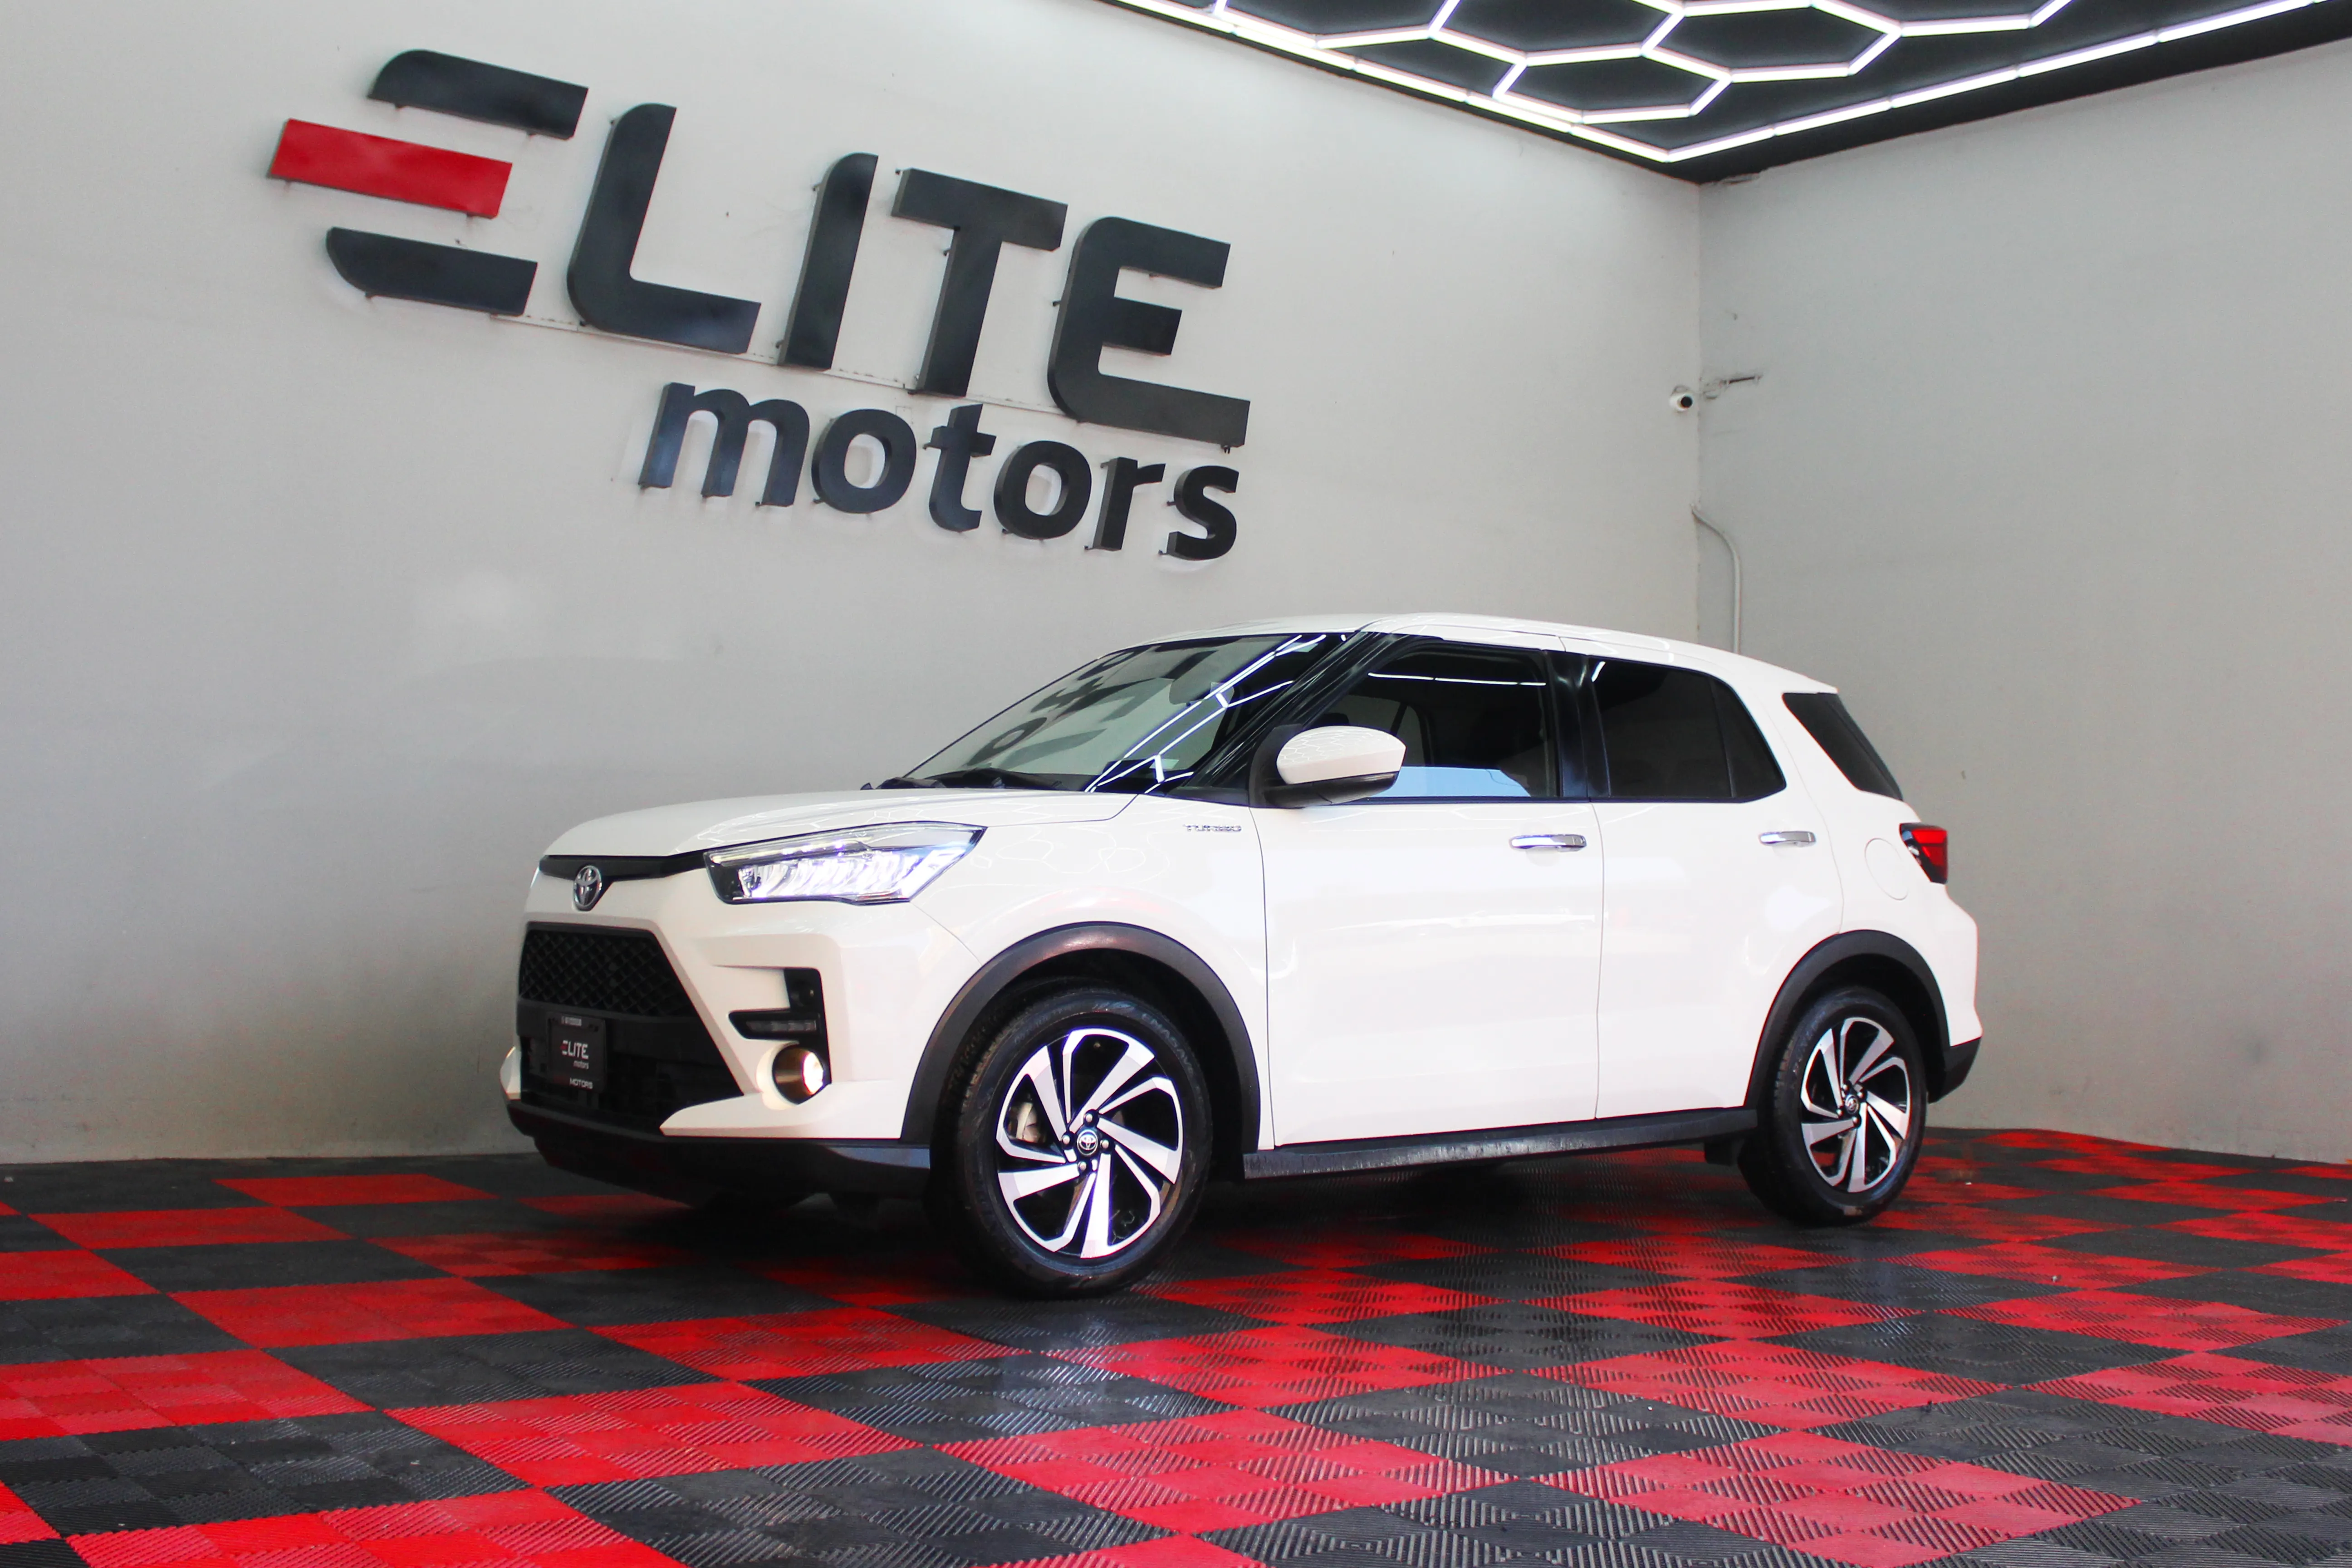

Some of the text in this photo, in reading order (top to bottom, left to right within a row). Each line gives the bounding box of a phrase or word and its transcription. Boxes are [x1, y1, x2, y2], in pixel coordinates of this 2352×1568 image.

[267, 49, 1250, 447] ELITE
[637, 381, 1240, 562] motors
[1183, 824, 1242, 832] TURBO
[560, 1039, 589, 1059] ELITE
[569, 1078, 593, 1089] MOTORS
